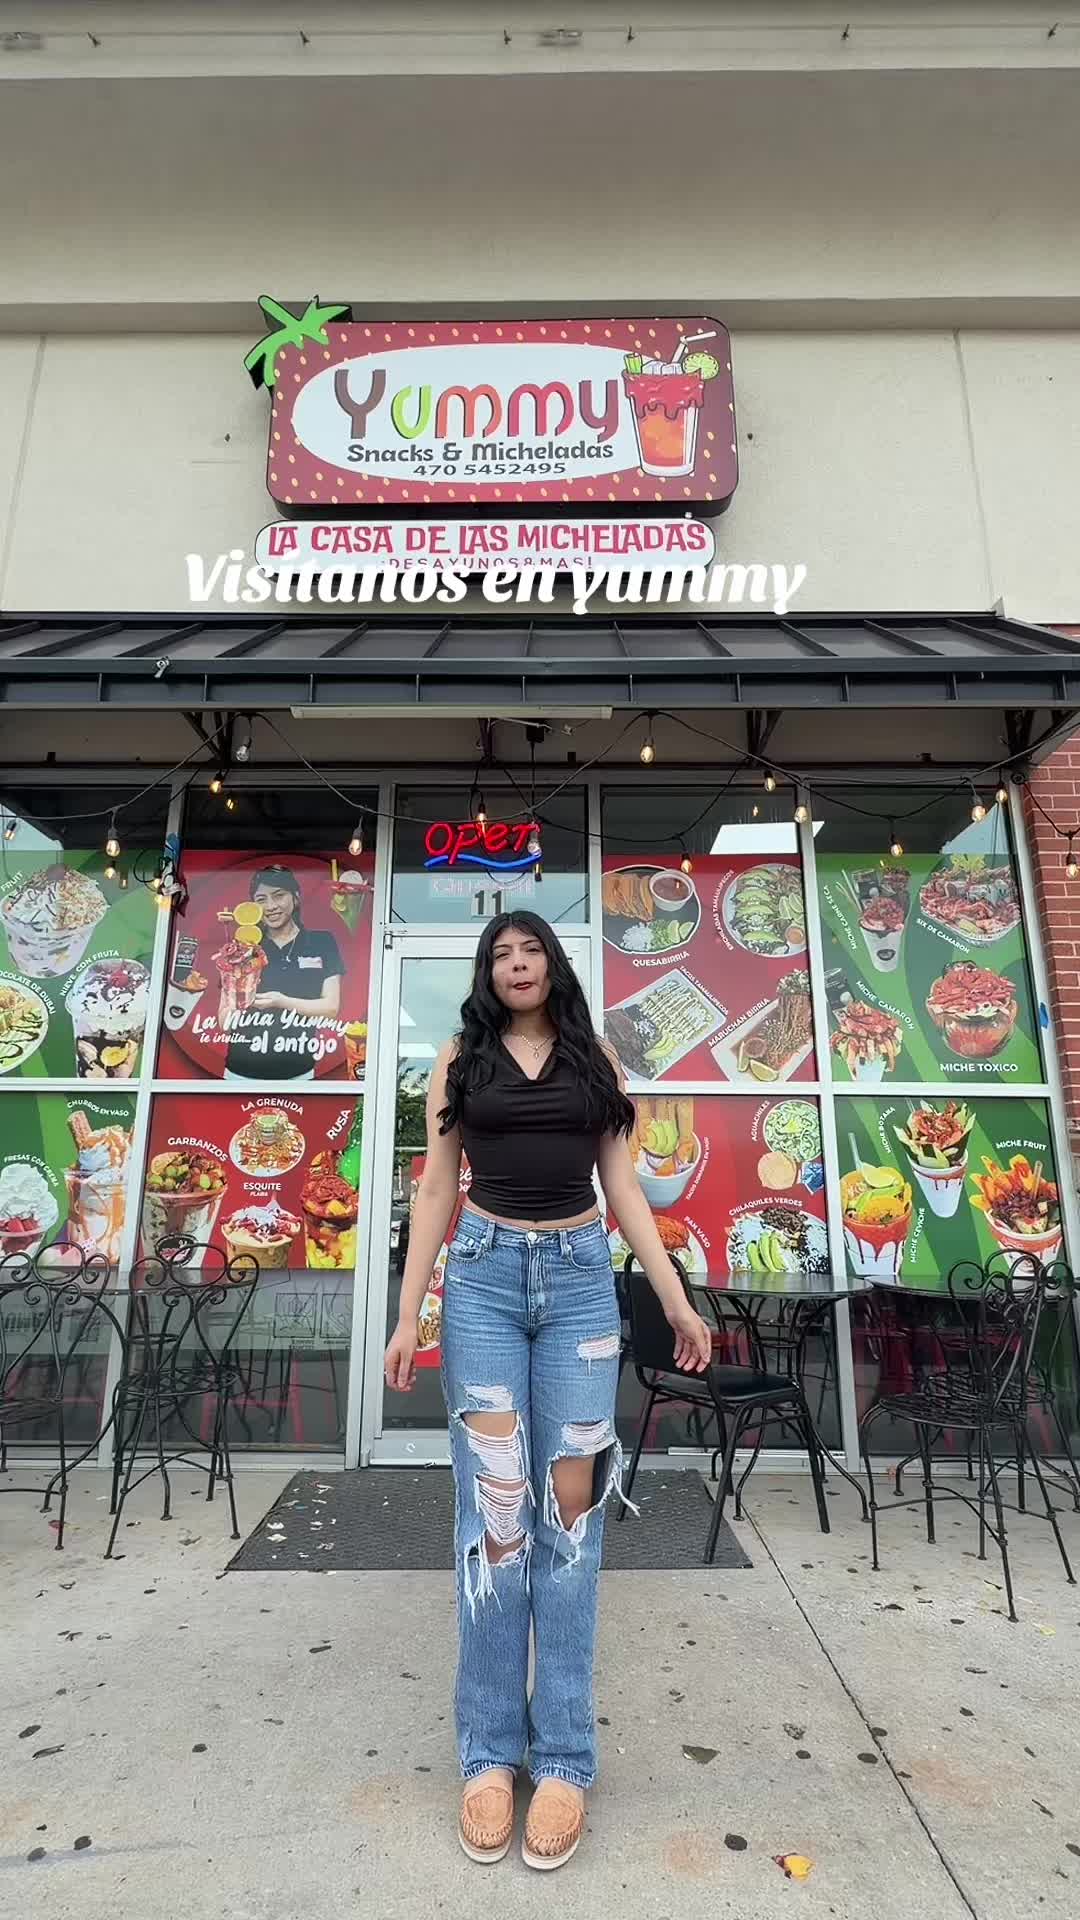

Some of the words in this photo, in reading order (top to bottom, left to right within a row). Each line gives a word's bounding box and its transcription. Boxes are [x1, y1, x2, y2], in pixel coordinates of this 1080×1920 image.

[334, 369, 619, 443] Yummy
[347, 444, 434, 462] Snacks
[442, 442, 463, 461] &
[472, 440, 614, 461] Micheladas
[413, 464, 457, 476] 470
[464, 462, 566, 475] 5452495
[268, 526, 298, 555] LA
[311, 526, 393, 554] CASA
[406, 526, 450, 553] DE
[459, 525, 508, 554] LAS
[517, 524, 706, 553] MICHELADAS
[475, 890, 502, 915] 11
[632, 951, 690, 967] QUESABIRRIA
[60, 974, 77, 997] NIEVE
[76, 957, 92, 972] CON
[92, 949, 120, 961] FRUTA
[31, 982, 42, 994] DE
[192, 1013, 218, 1034] La
[280, 1008, 349, 1037] Yummy
[708, 1014, 747, 1047] MARUCHAN
[200, 1032, 210, 1043] te
[250, 1029, 269, 1055] al
[273, 1031, 338, 1061] antojo
[940, 1063, 976, 1072] MICHE
[977, 1063, 1018, 1072] TOXICO
[109, 1109, 129, 1117] VASO
[241, 1101, 255, 1112] LA
[256, 1098, 304, 1115] GRENUDA
[326, 1108, 351, 1140] RUSA
[168, 1137, 228, 1162] GARBANZOS
[1023, 1140, 1047, 1151] FRUIT
[243, 1182, 282, 1191] ESQUITE
[728, 1197, 774, 1216] CHILAQUILES
[773, 1197, 803, 1207] VERDES
